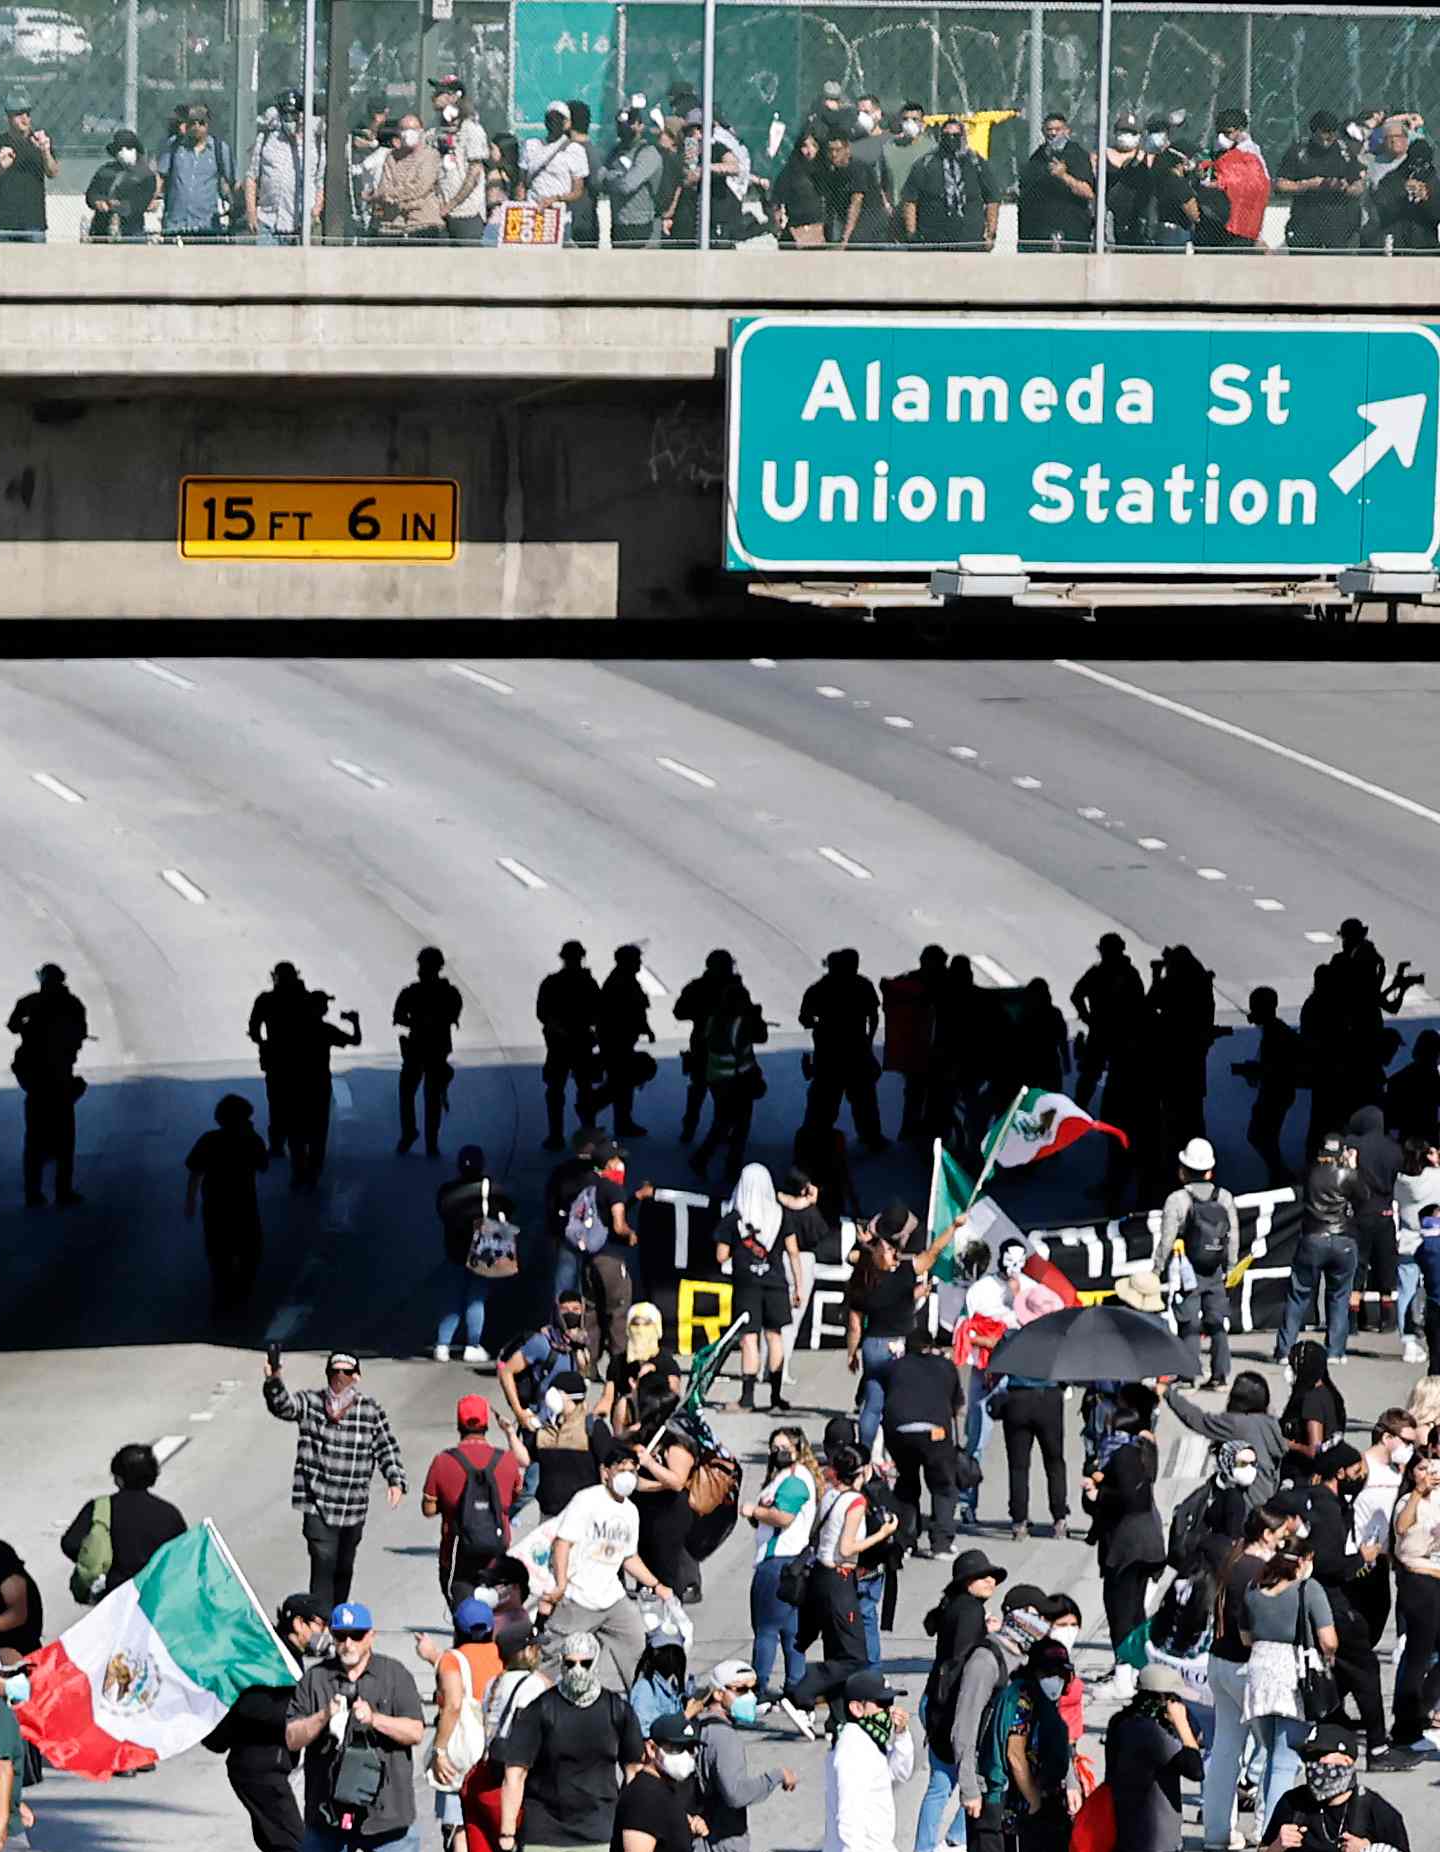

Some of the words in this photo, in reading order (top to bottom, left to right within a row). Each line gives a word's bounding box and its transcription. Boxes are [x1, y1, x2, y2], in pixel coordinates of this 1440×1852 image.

[801, 359, 1154, 425] Alameda
[1207, 362, 1291, 425] St
[203, 497, 256, 541] 15
[269, 511, 312, 541] FT
[348, 497, 381, 541] 6
[401, 512, 437, 541] IN
[761, 458, 985, 523] Union
[1028, 462, 1317, 525] Station
